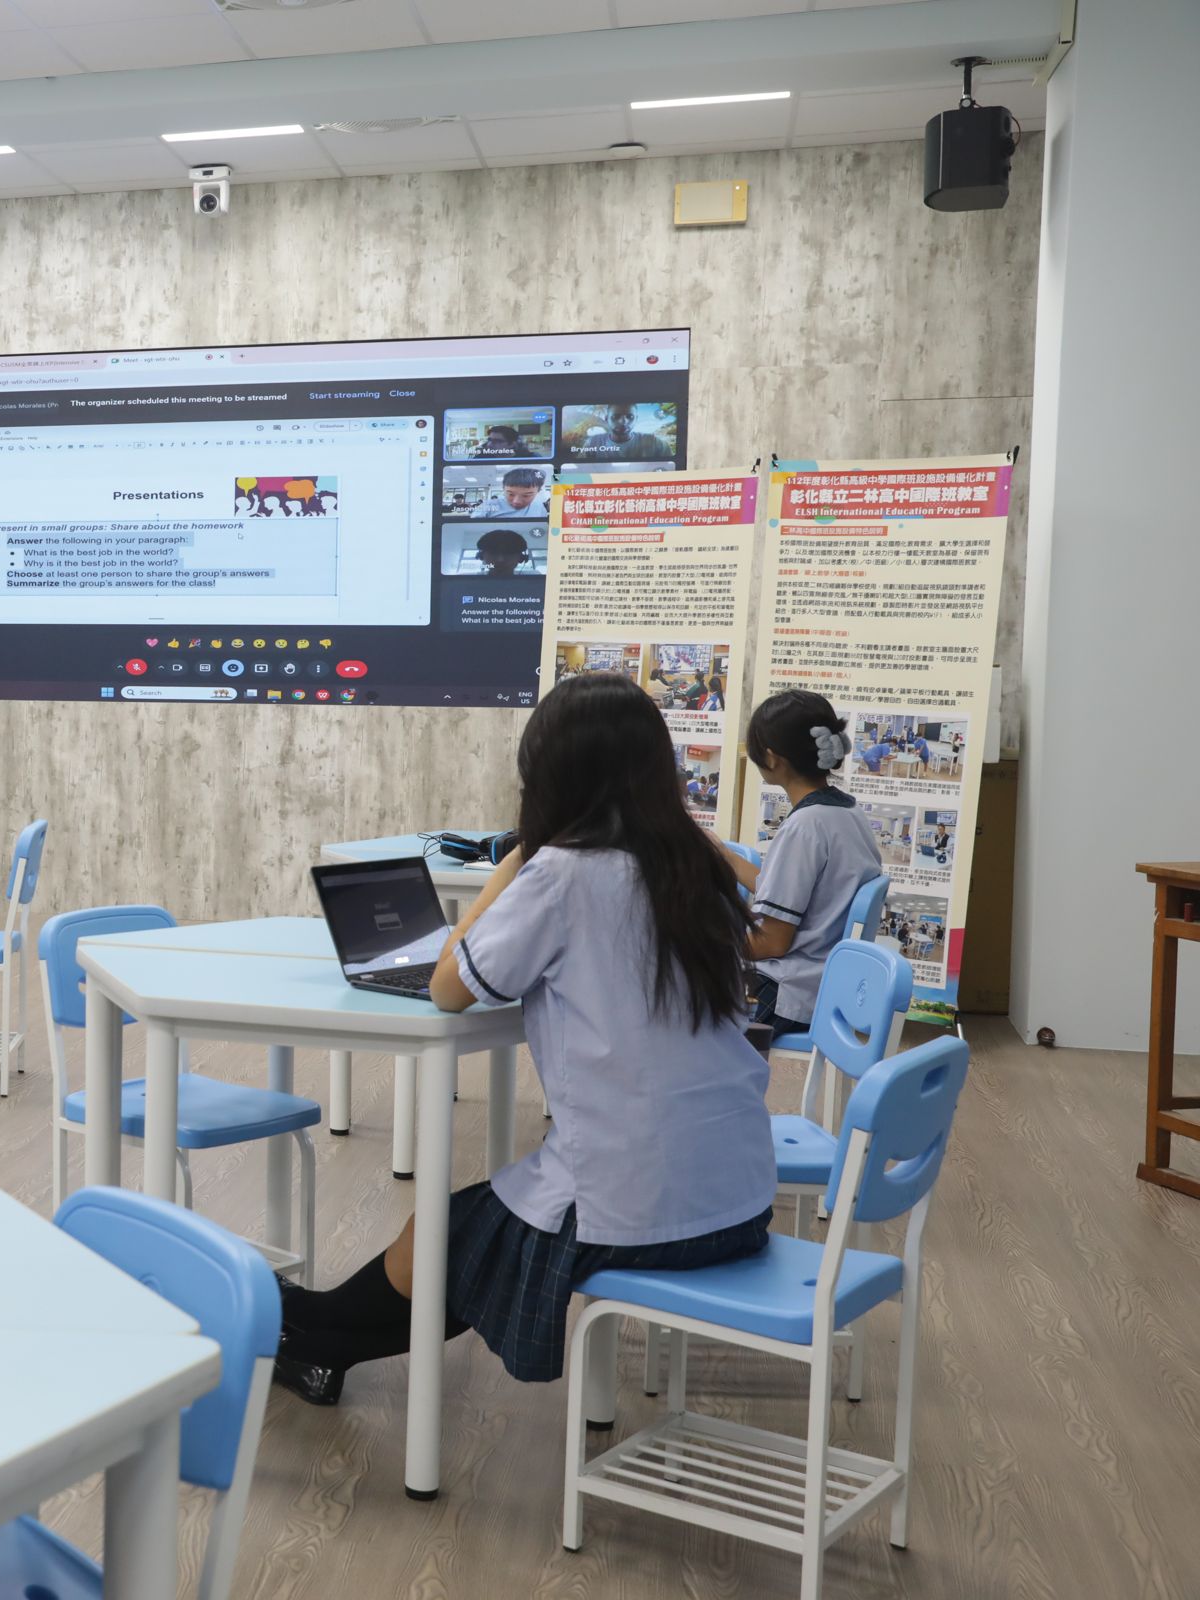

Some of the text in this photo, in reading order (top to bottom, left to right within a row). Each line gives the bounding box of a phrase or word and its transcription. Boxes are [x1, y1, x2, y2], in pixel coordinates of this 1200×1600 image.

[309, 389, 416, 400] Start streaming Close
[71, 392, 288, 408] The organizer scheduled this meeting to be streamed
[570, 446, 598, 454] Bryant
[113, 490, 204, 500] Presentations
[790, 486, 989, 504] 彰化縣立二林高中國際班教室
[795, 506, 981, 516] ELSH International Education Program
[594, 517, 648, 525] International
[649, 516, 690, 524] Education
[692, 515, 729, 524] Program
[41, 524, 67, 532] small
[69, 524, 108, 534] groups:
[110, 523, 139, 531] Share
[141, 523, 170, 531] about
[191, 522, 245, 530] homework
[7, 537, 43, 545] Answer
[46, 537, 60, 545] the
[62, 537, 102, 546] following
[115, 537, 136, 546] your
[138, 537, 189, 546] paragraph:
[98, 548, 113, 557] job
[126, 548, 140, 556] the
[143, 548, 174, 556] world?
[24, 560, 44, 568] Why
[102, 559, 117, 568] job
[130, 559, 145, 567] the
[147, 559, 178, 567] world?
[7, 570, 44, 578] Choose
[57, 570, 79, 578] least
[101, 571, 132, 579] person
[193, 570, 227, 578] group's
[79, 580, 113, 589] group's
